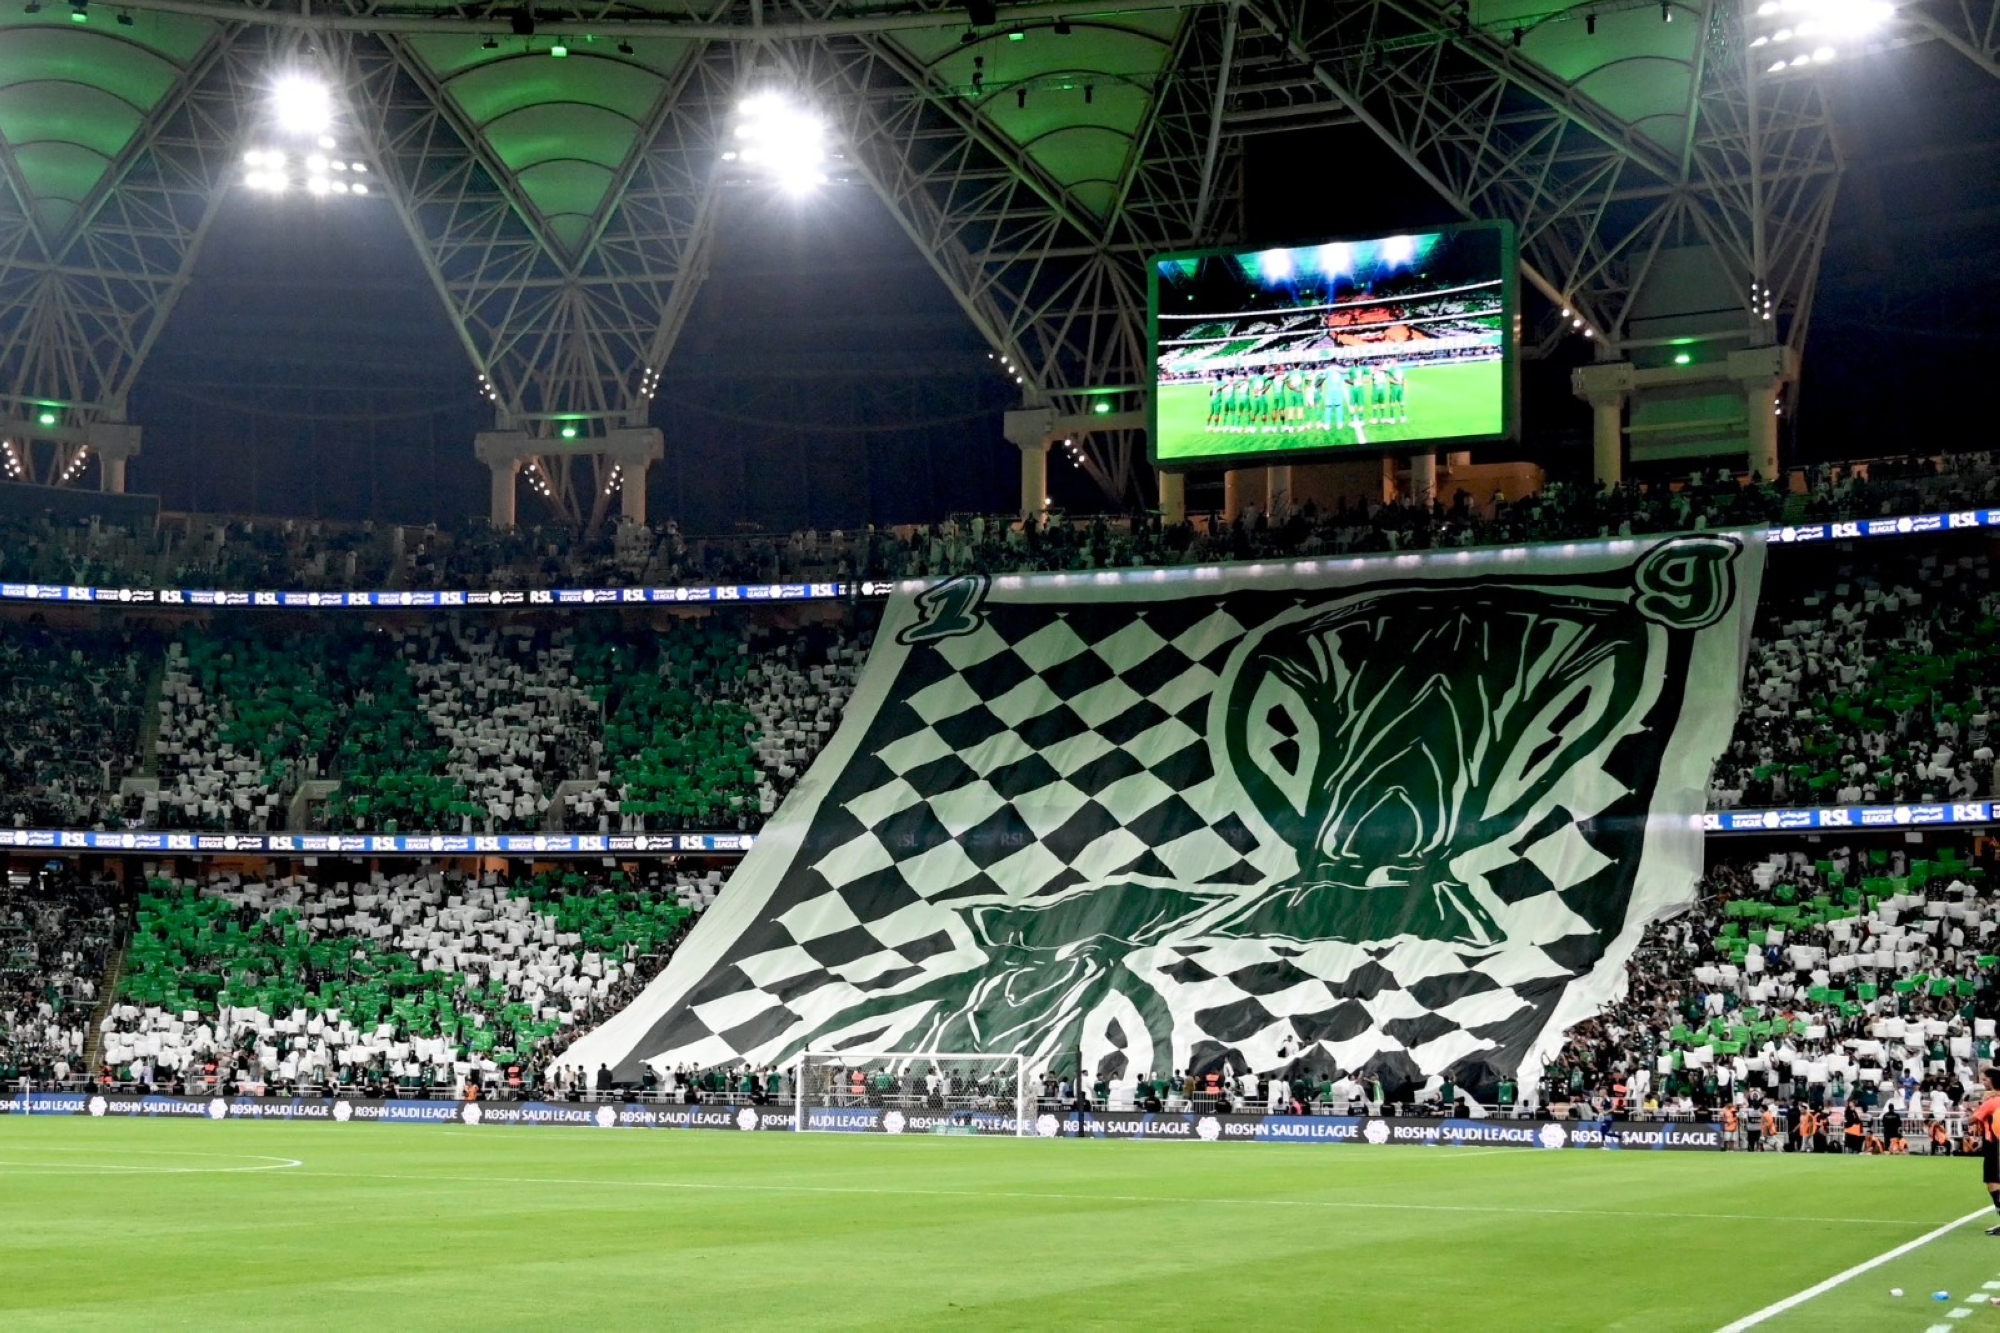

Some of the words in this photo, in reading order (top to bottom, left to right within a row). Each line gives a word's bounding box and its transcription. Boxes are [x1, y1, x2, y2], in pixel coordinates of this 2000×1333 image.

[1949, 512, 1980, 527] RSL
[1831, 523, 1861, 537] RSL
[68, 587, 92, 600] RSL
[160, 590, 184, 602] RSL
[529, 591, 554, 602] RSL
[623, 589, 648, 601] RSL
[716, 587, 740, 599] RSL
[811, 584, 836, 596] RSL
[254, 593, 279, 604] RSL
[348, 593, 372, 605] RSL
[440, 592, 464, 604] RSL
[1819, 809, 1853, 825] RSL
[1952, 803, 1987, 821] RSL
[1703, 814, 1723, 829] SL
[61, 832, 88, 846] RSL
[167, 835, 194, 849] RSL
[269, 836, 295, 850] RSL
[372, 837, 399, 850] RSL
[474, 836, 501, 850] RSL
[578, 836, 605, 850] RSL
[679, 836, 706, 849] RSL
[52, 1101, 85, 1111] LEAGUE
[109, 1101, 140, 1112] ROSHN
[143, 1102, 169, 1112] SAUDI
[171, 1103, 205, 1113] LEAGUE
[230, 1104, 262, 1115] ROSHN
[264, 1105, 292, 1116] SAUDI
[294, 1106, 328, 1116] LEAGUE
[354, 1106, 389, 1117] ROSHN
[391, 1107, 420, 1118] SAUDI
[421, 1108, 458, 1119] LEAGUE
[485, 1109, 520, 1120] ROSHN
[522, 1110, 552, 1121] SAUDI
[554, 1110, 591, 1122] LEAGUE
[620, 1111, 656, 1123] ROSHN
[659, 1112, 691, 1124] SAUDI
[692, 1113, 731, 1125] LEAGUE
[808, 1116, 835, 1127] AUDI
[837, 1116, 878, 1128] LEAGUE
[1108, 1121, 1143, 1133] SAUDI
[1145, 1122, 1190, 1134] LEAGUE
[1225, 1123, 1269, 1135] ROSHN
[1272, 1124, 1309, 1136] SAUDI
[1311, 1125, 1358, 1137] LEAGUE
[1394, 1127, 1440, 1139] ROSHN
[1443, 1128, 1482, 1140] SAUDI
[1484, 1129, 1534, 1142] LEAGUE
[1622, 1131, 1664, 1144] SAUDI
[1665, 1133, 1718, 1145] LEAGUE
